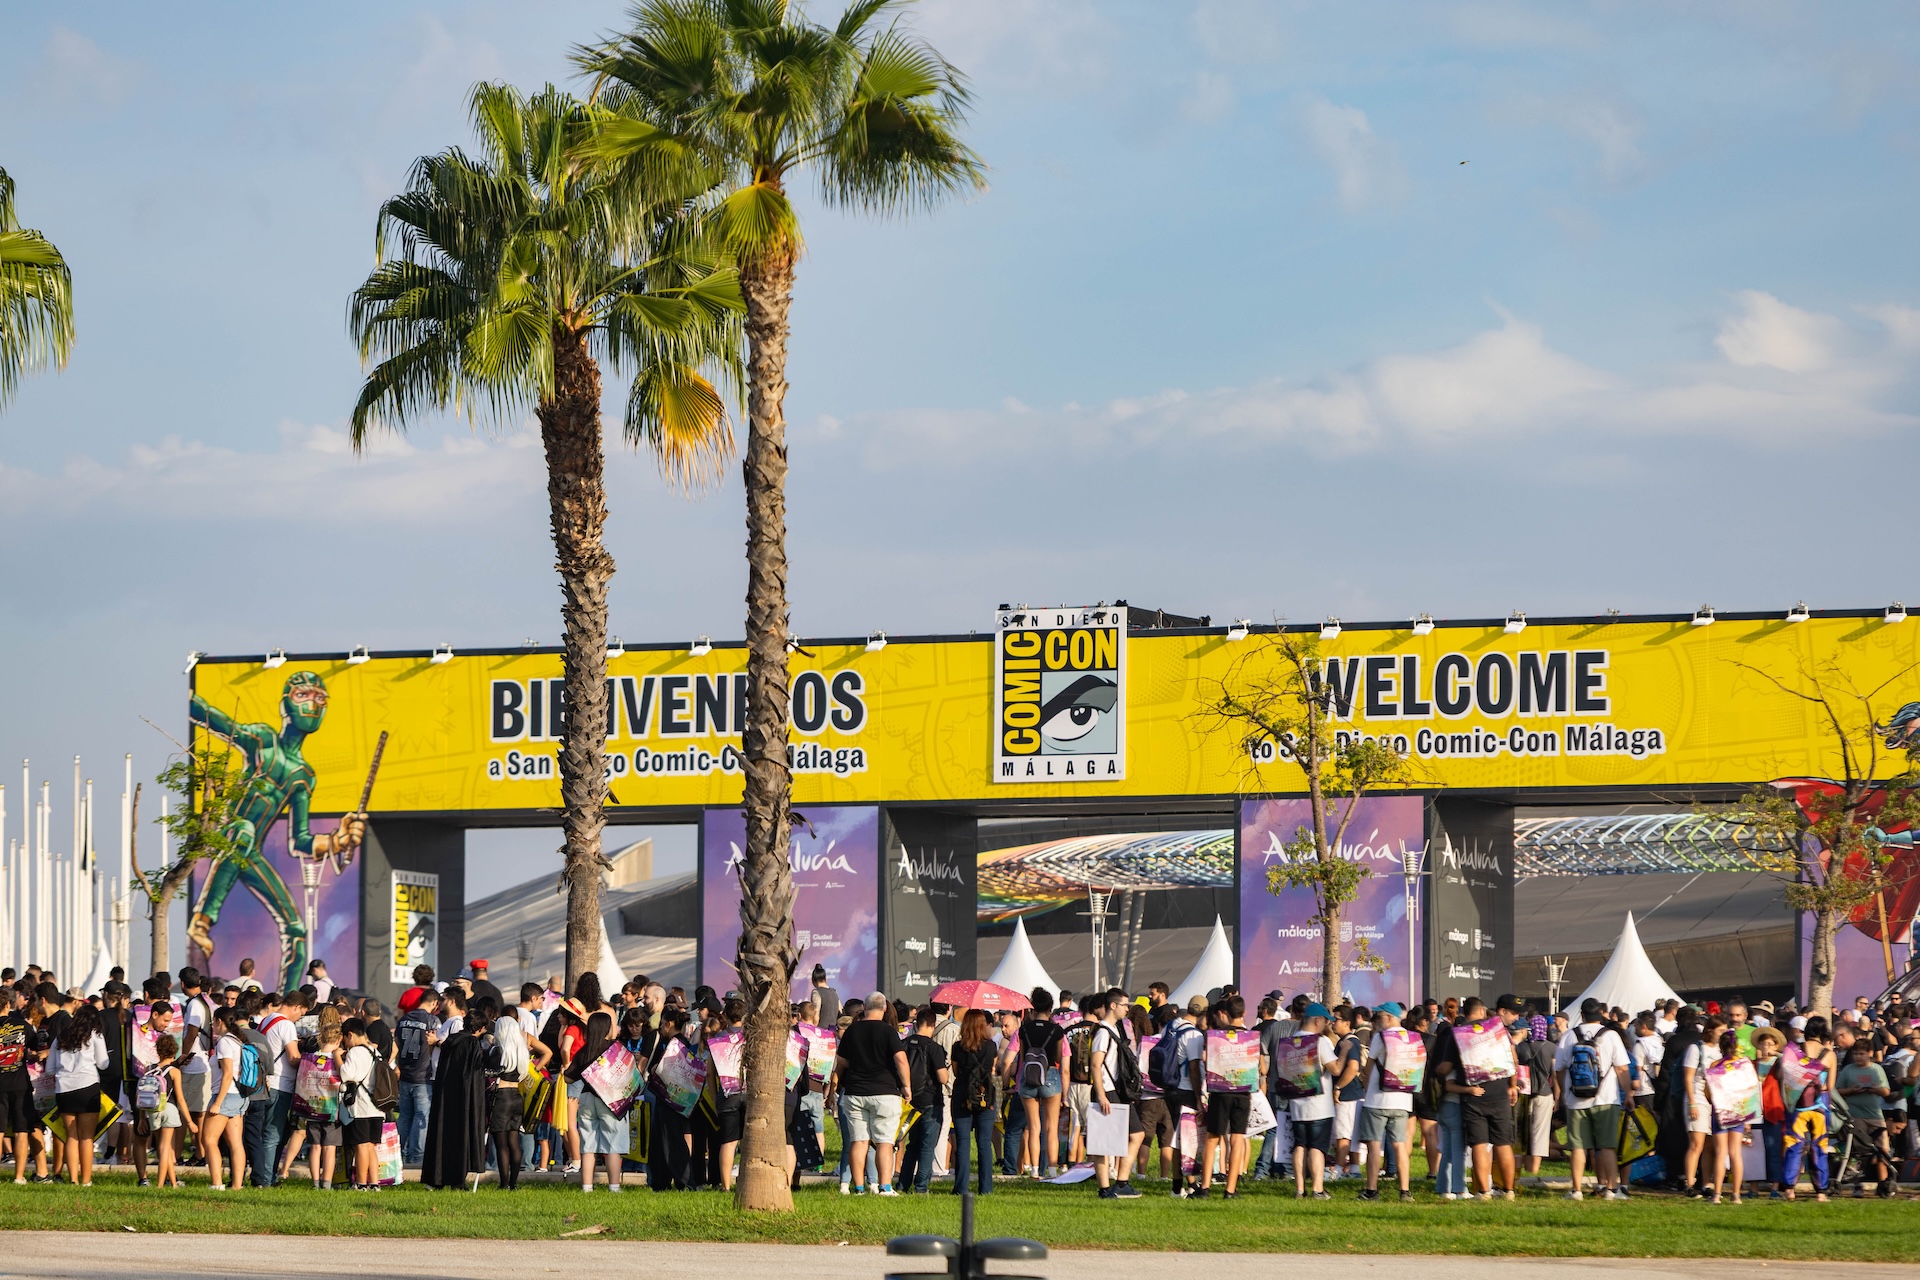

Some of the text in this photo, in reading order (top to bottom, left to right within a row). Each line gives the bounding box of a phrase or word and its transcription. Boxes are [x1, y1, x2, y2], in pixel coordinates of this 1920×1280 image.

[1057, 613, 1118, 626] DIEGO
[1045, 629, 1117, 670] CON
[493, 672, 864, 738] BIEVENIOS
[1004, 631, 1041, 754] COMIC
[1305, 652, 1606, 717] WELCOME
[1418, 727, 1557, 754] Comic-Con
[1567, 725, 1662, 755] Málaga
[490, 762, 500, 776] a
[508, 752, 550, 775] San
[636, 747, 746, 772] Comic-C
[1002, 758, 1116, 776] MÁLAGA
[898, 843, 964, 885] Andalucía
[1442, 832, 1502, 876] Andalucía
[410, 885, 435, 912] CON
[396, 884, 410, 966] COMIC
[401, 1028, 420, 1060] 74
